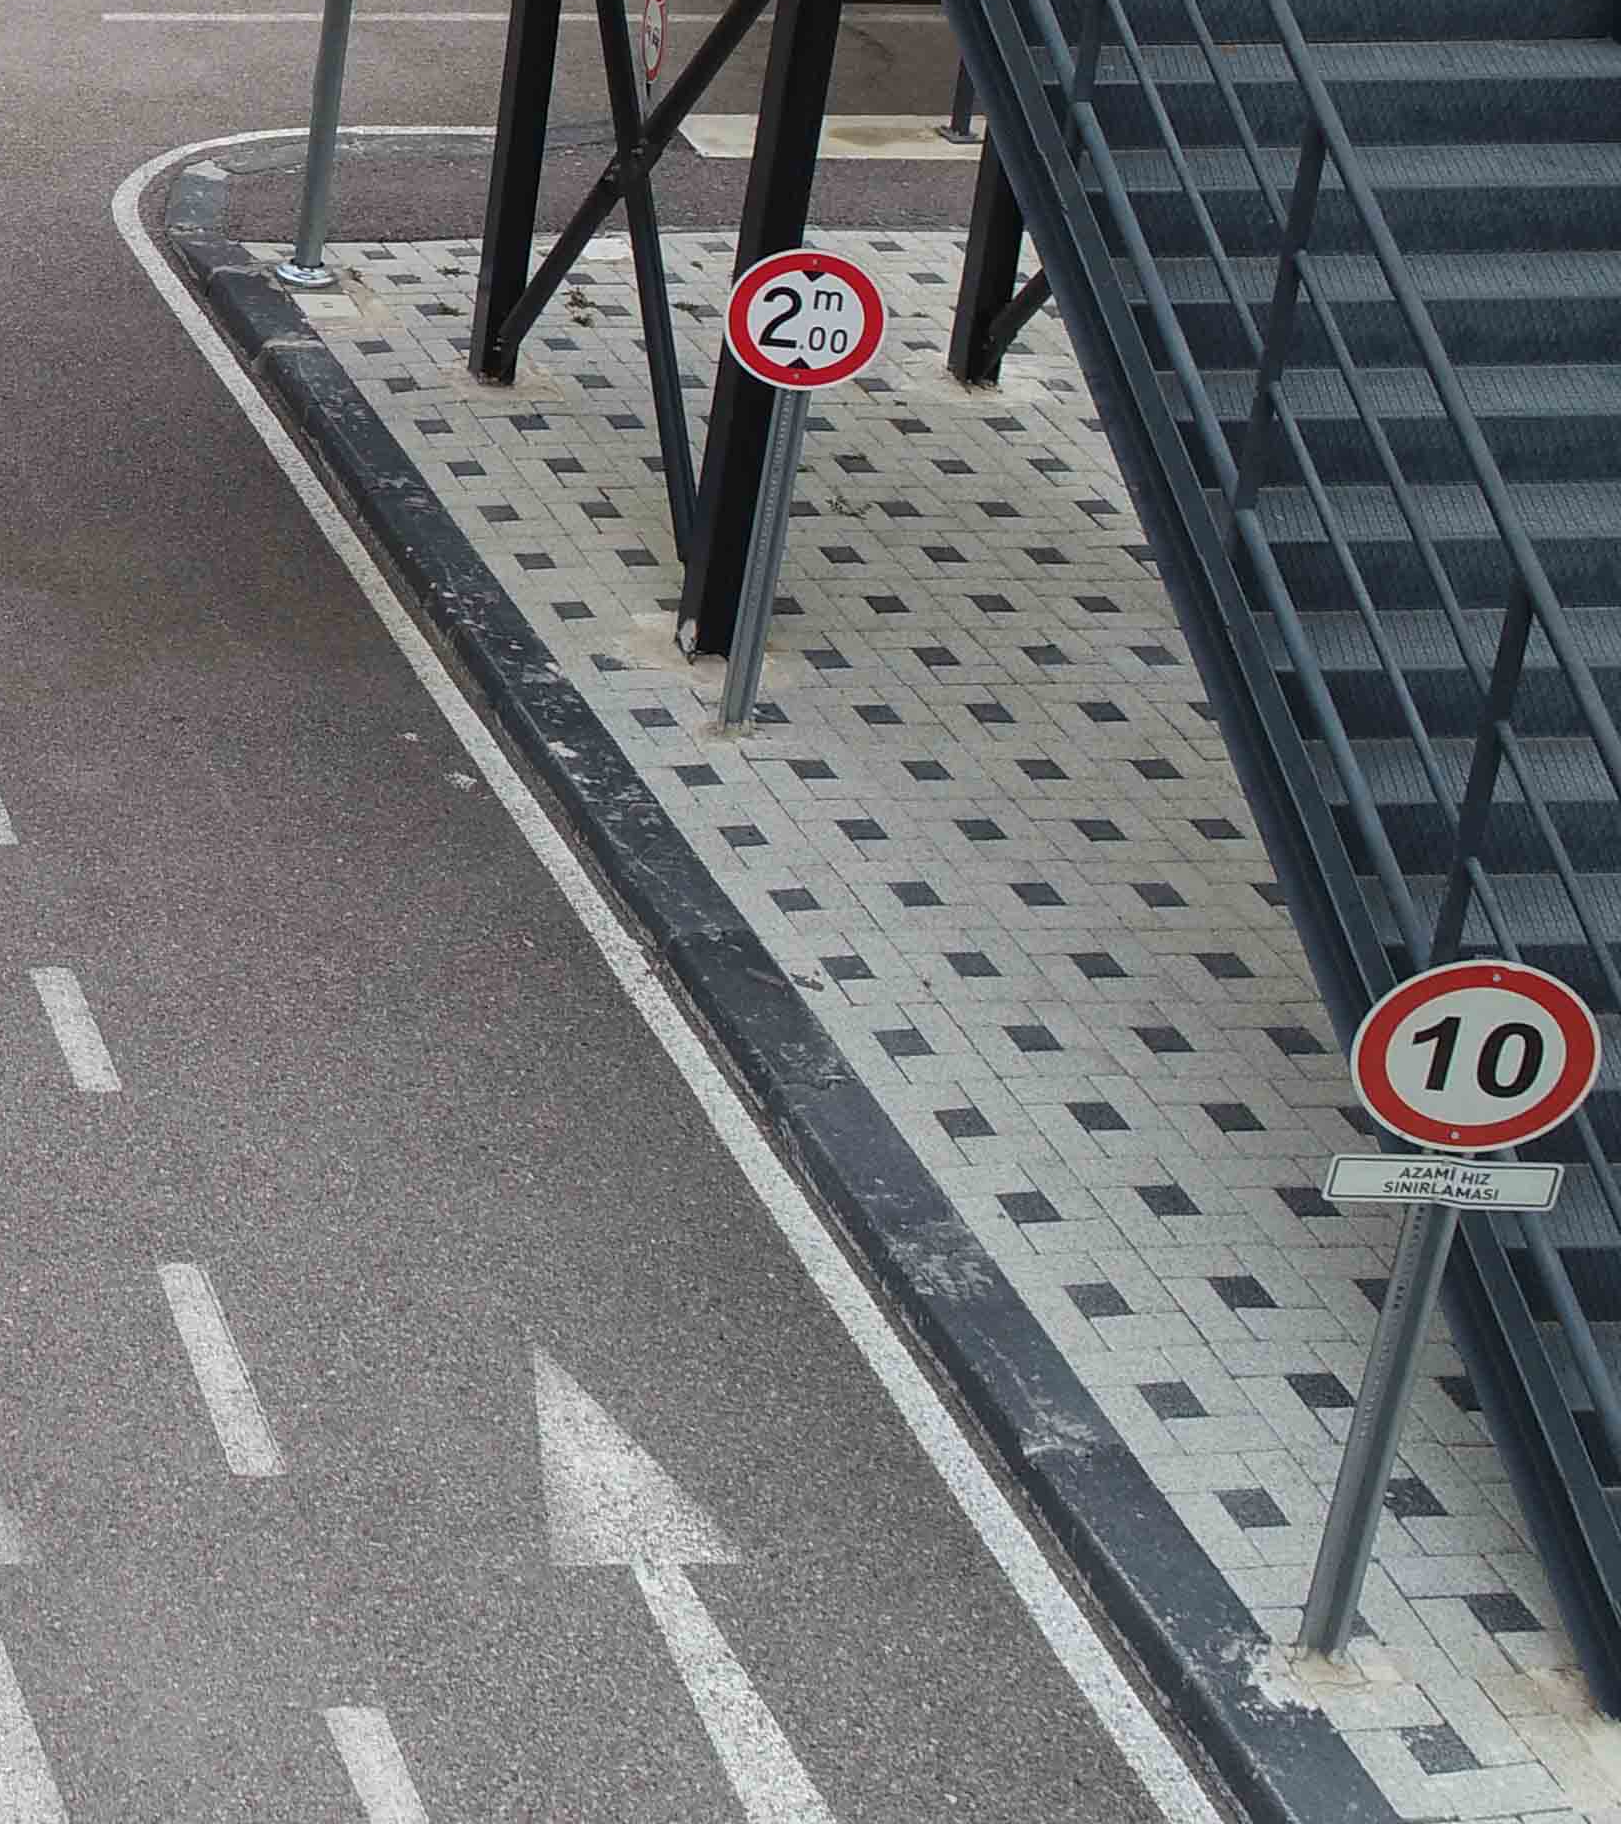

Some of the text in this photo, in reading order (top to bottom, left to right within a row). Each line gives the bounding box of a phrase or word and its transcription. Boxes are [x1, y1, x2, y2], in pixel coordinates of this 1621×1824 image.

[1413, 1016, 1545, 1098] 10
[1398, 1166, 1493, 1186] AZAMİ HIZ
[1381, 1180, 1501, 1202] SINIRLAMASI
